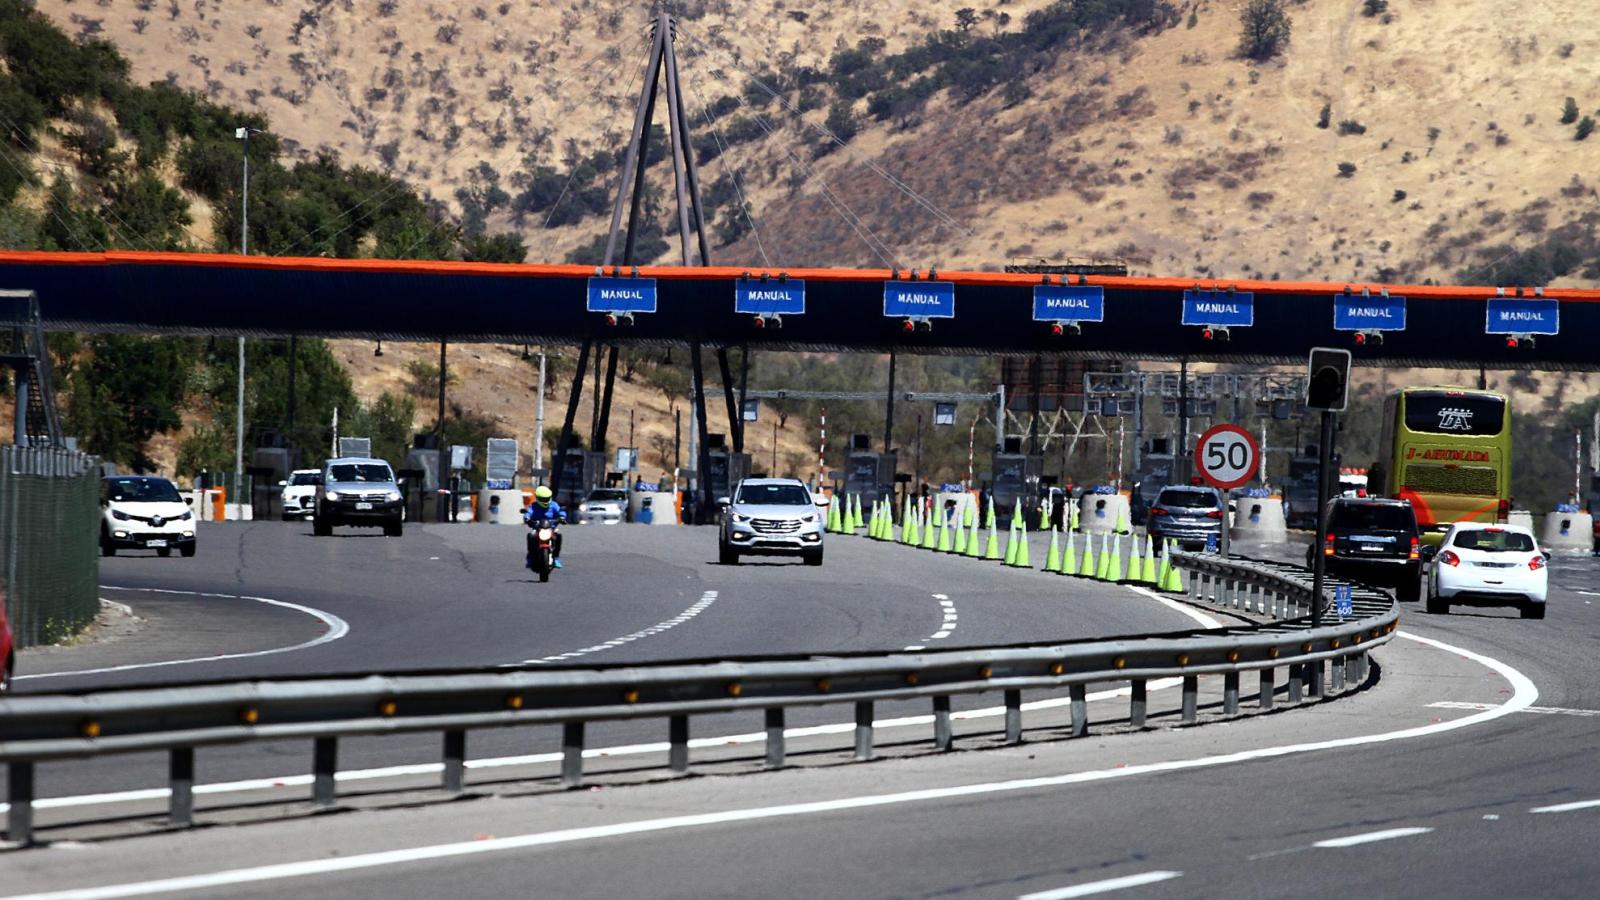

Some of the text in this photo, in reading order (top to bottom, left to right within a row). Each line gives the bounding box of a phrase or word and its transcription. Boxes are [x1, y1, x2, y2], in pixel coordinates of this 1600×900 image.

[601, 289, 643, 300] MANUAL
[748, 290, 792, 301] MANUAL
[897, 293, 941, 305] MANUAL
[1046, 298, 1090, 309] MANUAL
[1196, 303, 1239, 314] MANUAL
[1348, 307, 1392, 318] MANUAL
[1500, 311, 1544, 321] MANUAL
[1207, 441, 1248, 470] 50
[1337, 606, 1353, 615] 600
